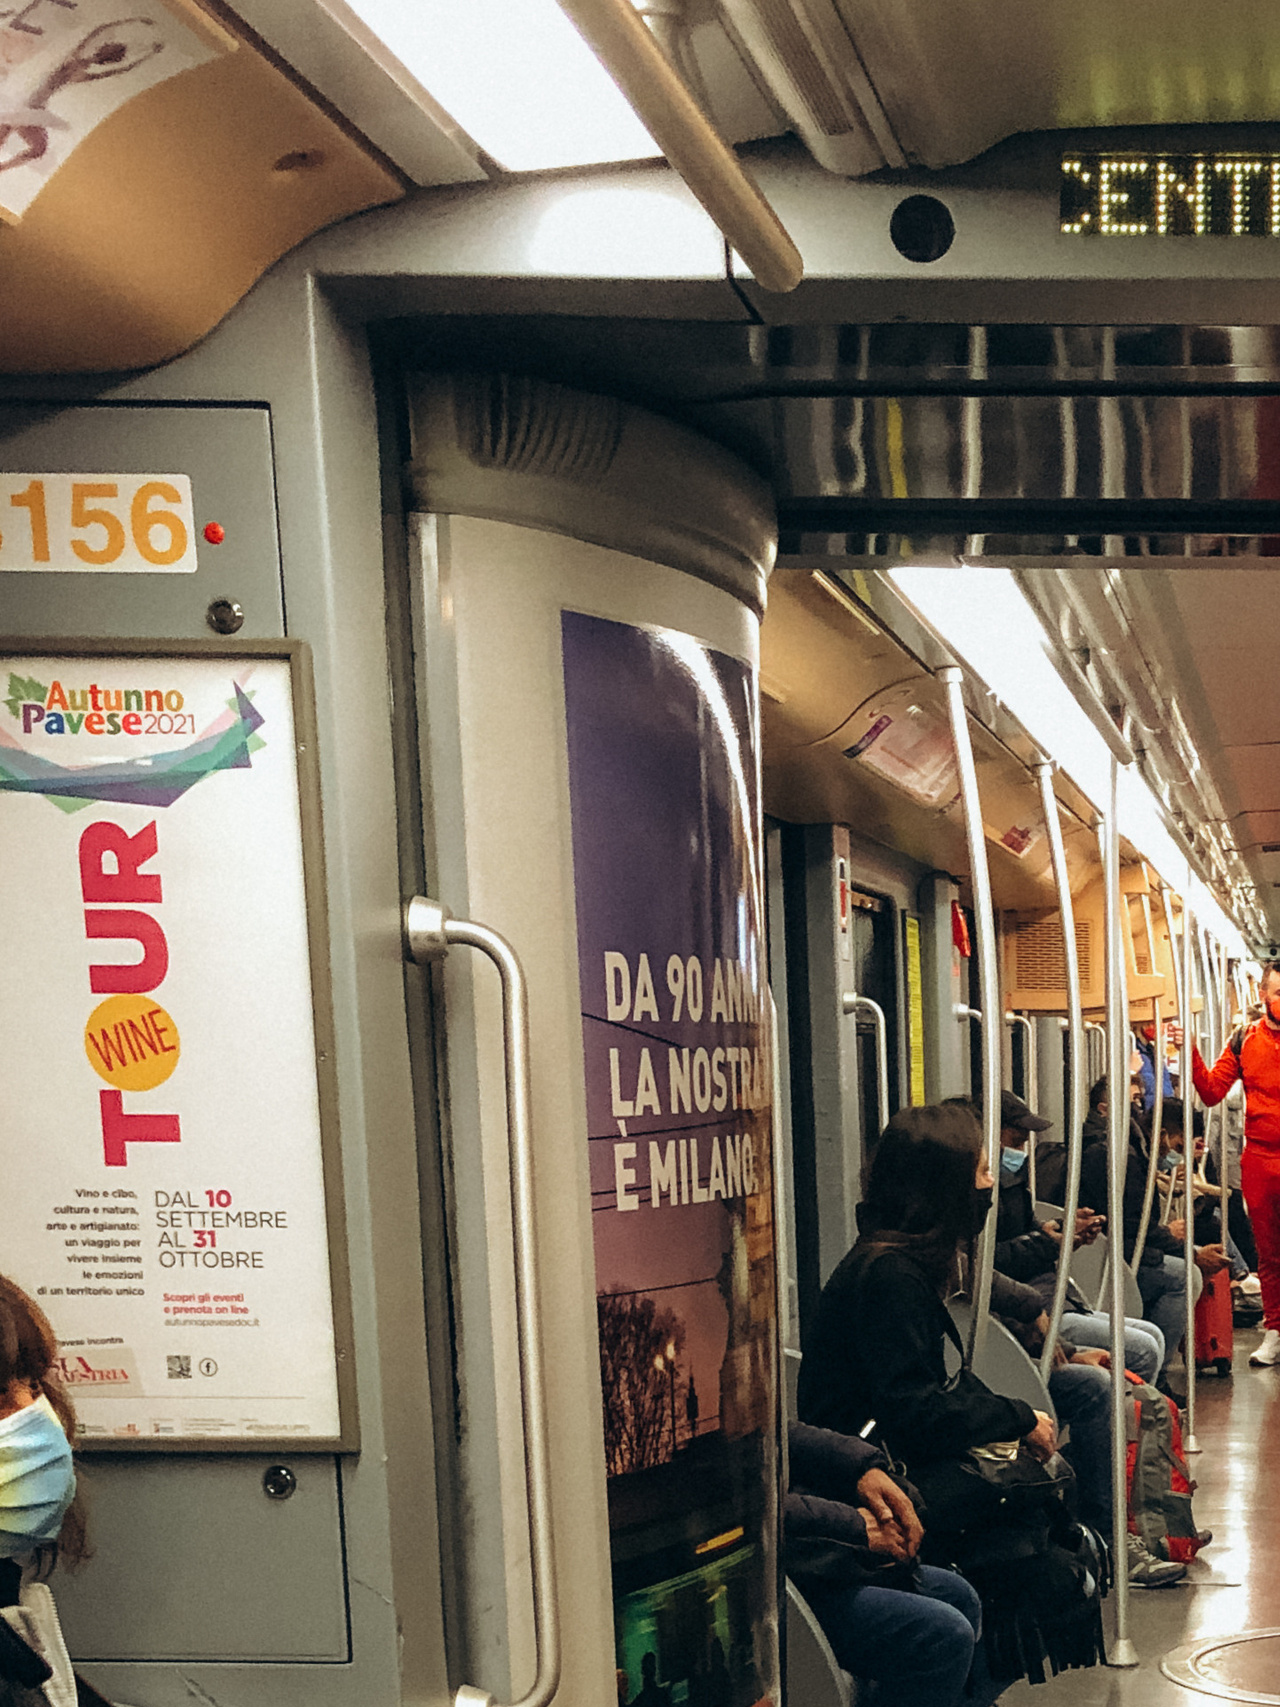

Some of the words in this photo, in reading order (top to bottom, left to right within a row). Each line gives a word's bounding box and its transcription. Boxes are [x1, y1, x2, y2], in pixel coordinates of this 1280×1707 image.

[0, 480, 188, 566] 156
[45, 680, 185, 713] Autunno
[22, 703, 143, 736] Pavese
[144, 713, 196, 735] 2021
[604, 950, 660, 1022] DA
[666, 953, 704, 1023] 90
[88, 1008, 177, 1072] WINE
[609, 1047, 662, 1117] LA
[614, 1119, 640, 1212] È
[75, 1188, 100, 1198] Vino
[102, 1190, 109, 1198] e
[111, 1188, 138, 1199] cibo,
[154, 1190, 200, 1208] DAL
[204, 1189, 232, 1208] 10
[53, 1205, 90, 1214] cultura
[93, 1206, 99, 1214] e
[102, 1206, 139, 1215] natura,
[156, 1210, 288, 1228] SETTEMBRE
[46, 1222, 68, 1230] arte
[79, 1222, 140, 1232] artigianato:
[64, 1239, 79, 1247] un
[81, 1238, 121, 1249] viaggio
[123, 1239, 142, 1248] per
[158, 1230, 186, 1248] AL
[193, 1229, 217, 1248] 31
[67, 1254, 99, 1263] vivere
[102, 1254, 142, 1263] insieme
[159, 1250, 265, 1269] OTTOBRE
[82, 1270, 92, 1279] le
[95, 1270, 144, 1279] emozioni
[37, 1286, 47, 1295] di
[50, 1287, 63, 1295] un
[66, 1286, 113, 1296] territorio
[115, 1286, 145, 1296] unico
[163, 1292, 196, 1303] Scopri
[197, 1292, 211, 1303] gli
[212, 1292, 244, 1302] eventi
[163, 1306, 170, 1314] e
[172, 1305, 212, 1315] prenota
[215, 1306, 228, 1314] on
[230, 1304, 249, 1314] line
[58, 1339, 85, 1347] avese
[87, 1336, 124, 1346] incontra
